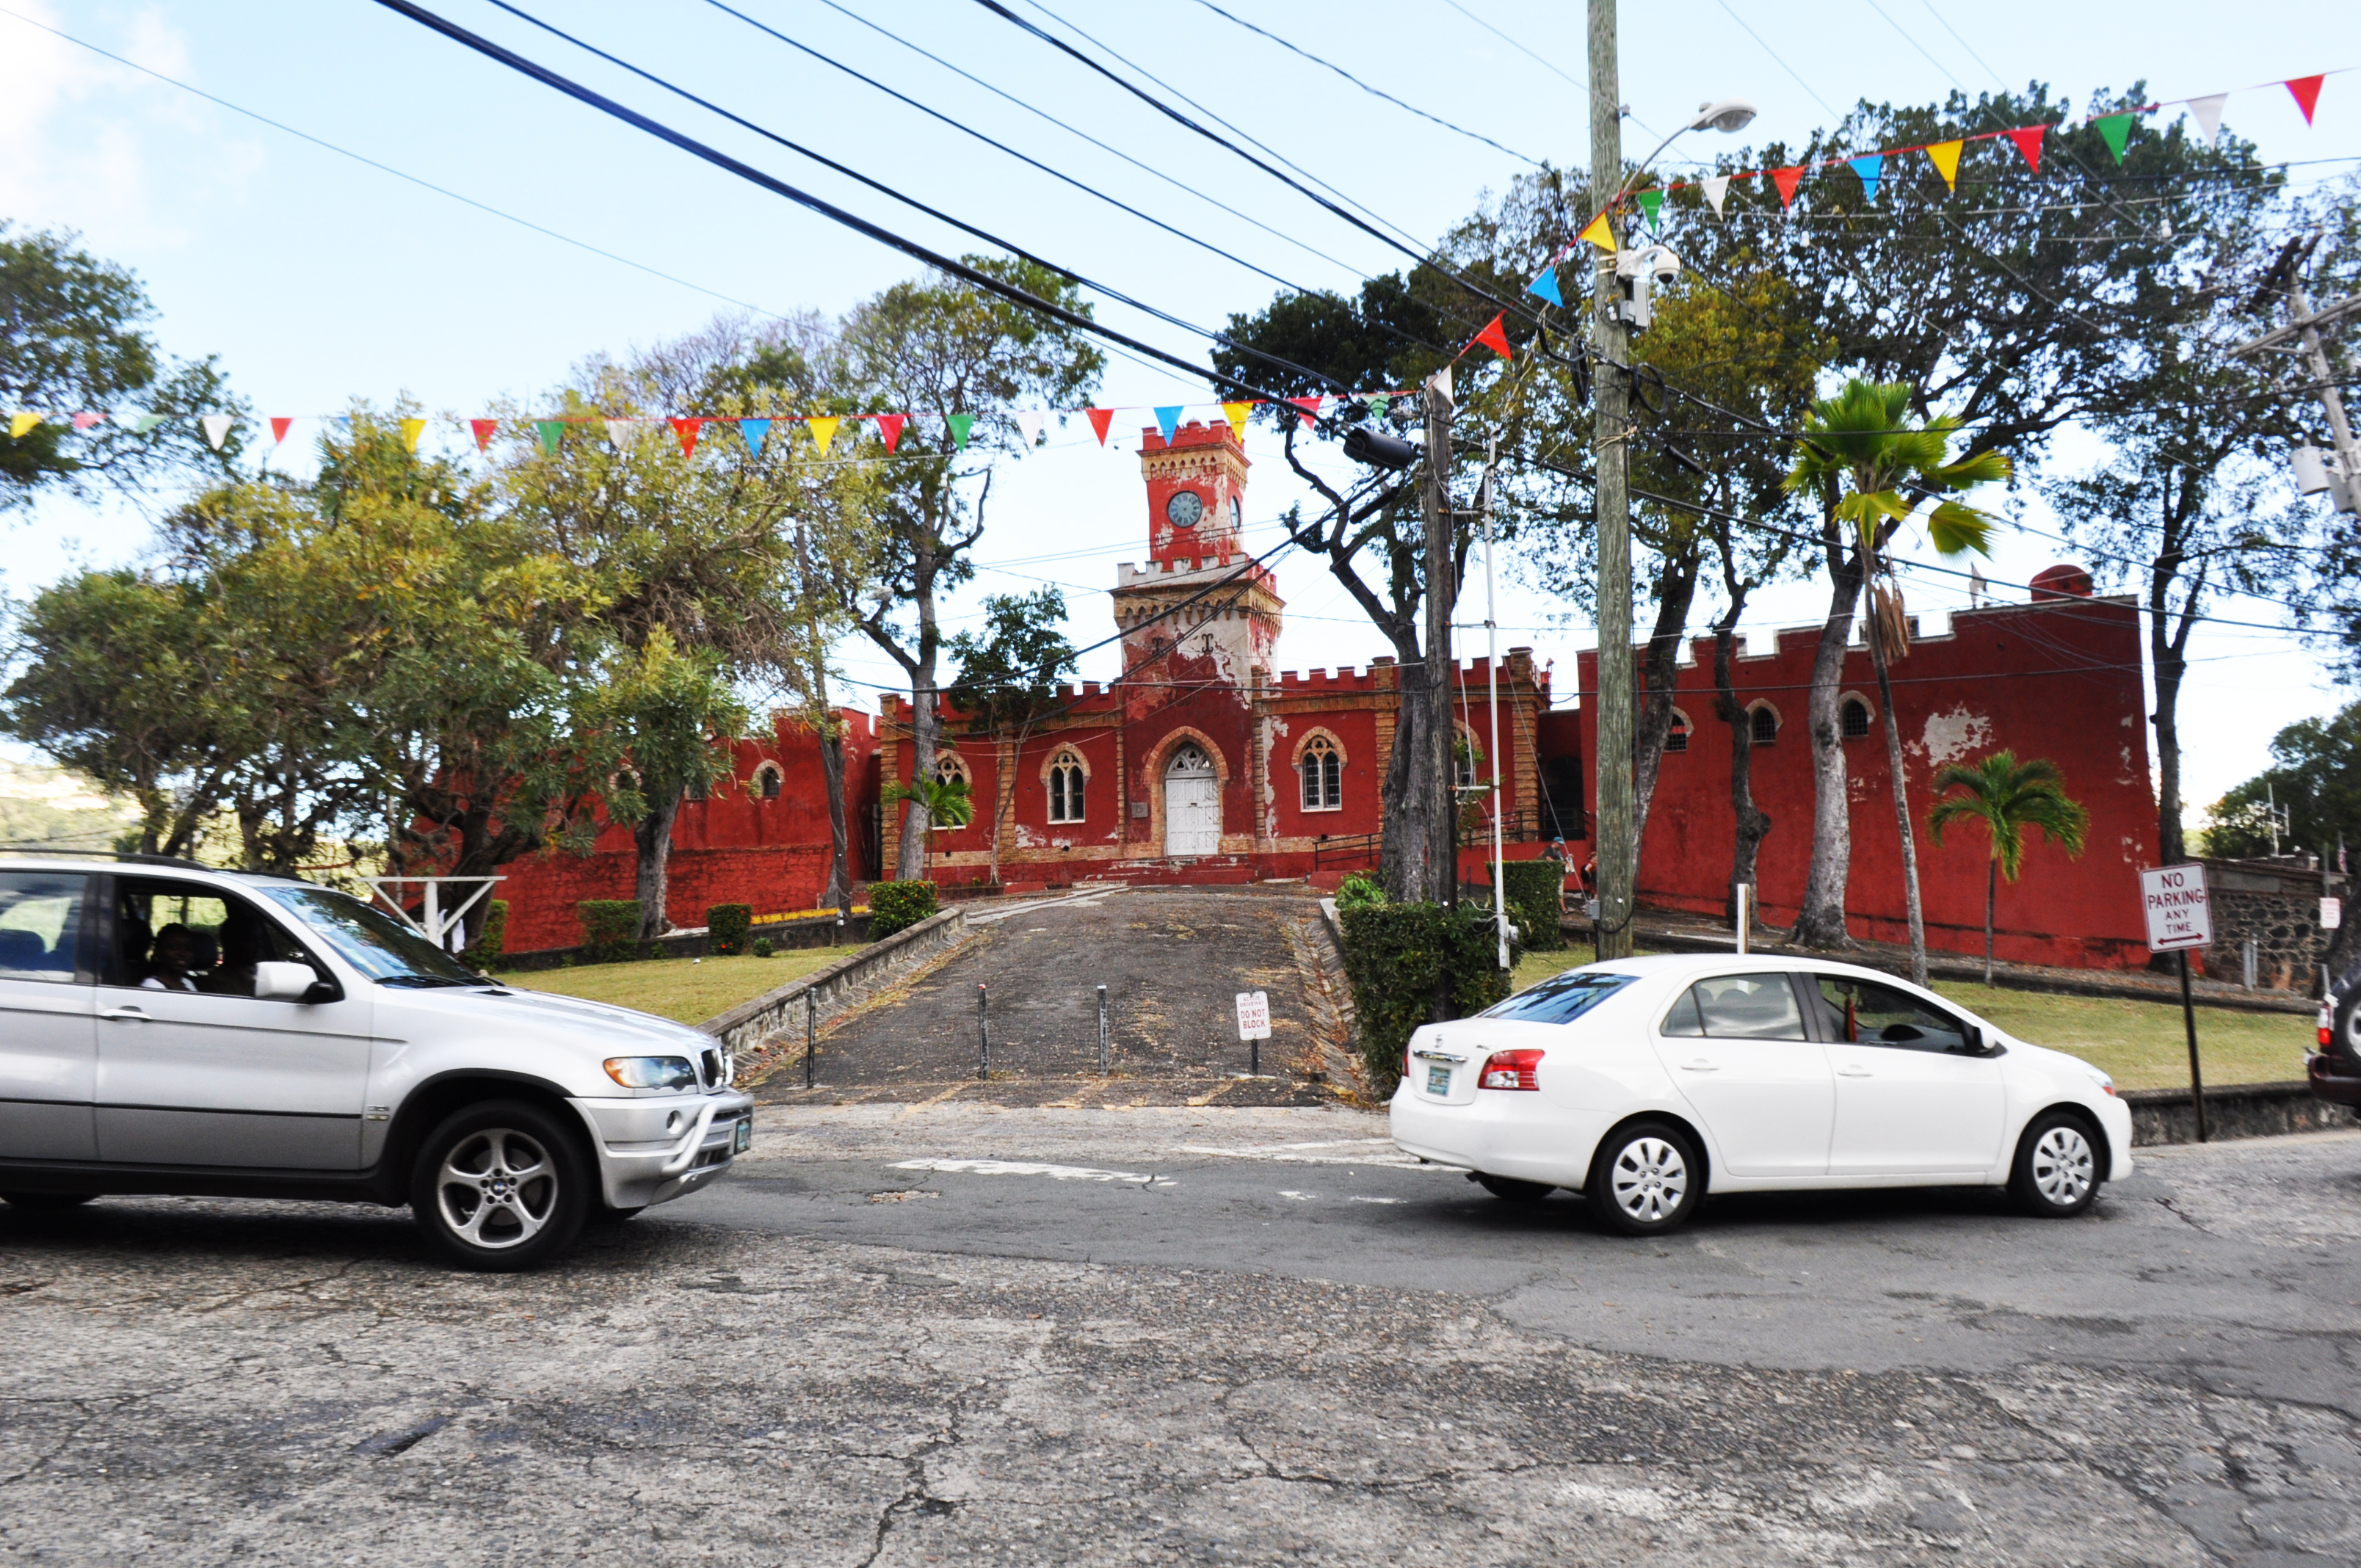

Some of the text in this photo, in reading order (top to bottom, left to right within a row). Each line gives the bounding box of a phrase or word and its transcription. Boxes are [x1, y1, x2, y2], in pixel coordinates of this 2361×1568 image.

[2161, 872, 2184, 889] NO
[2148, 888, 2205, 910] PARKING
[2166, 909, 2189, 921] ANY
[2166, 922, 2192, 934] TIME
[1241, 1009, 1265, 1019] DO NOT
[1243, 1019, 1266, 1028] BLOCK
